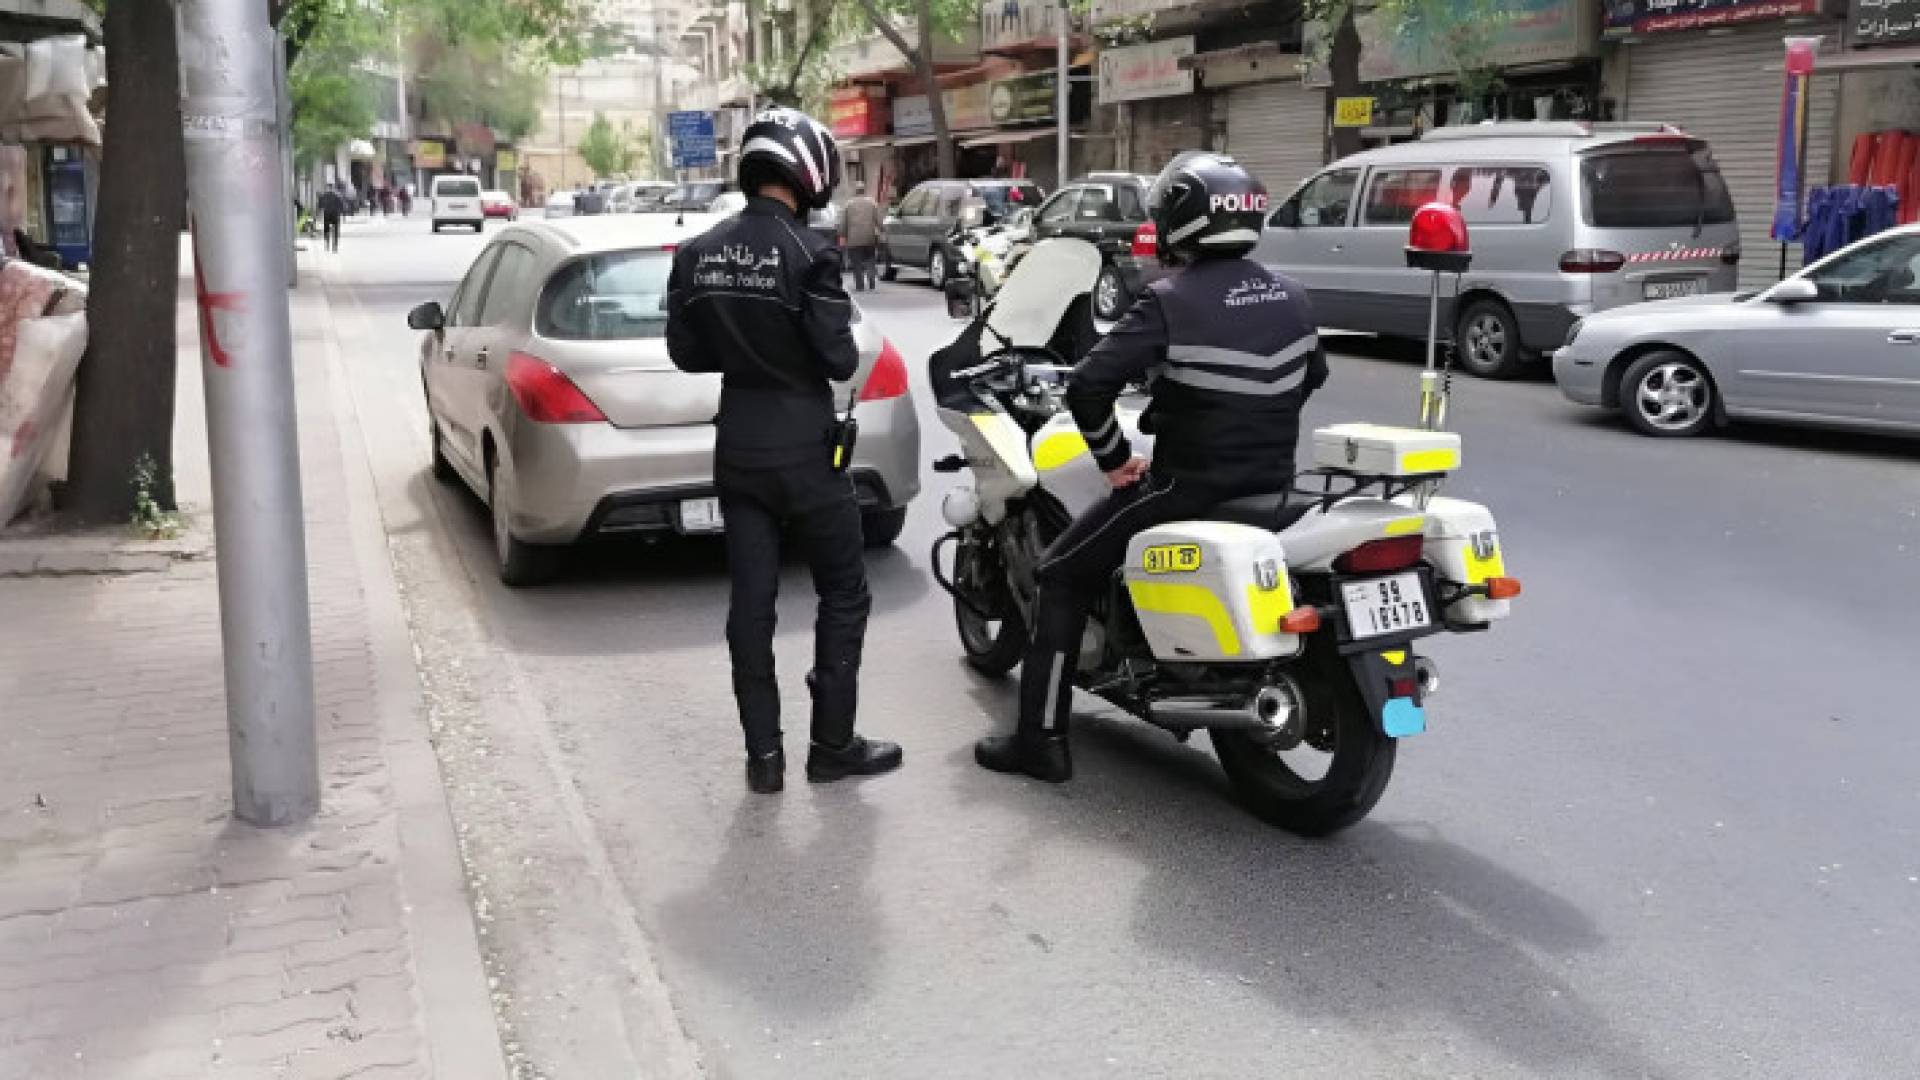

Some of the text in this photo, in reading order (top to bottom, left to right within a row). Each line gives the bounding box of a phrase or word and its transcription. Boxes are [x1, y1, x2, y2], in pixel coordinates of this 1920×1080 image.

[696, 243, 780, 271] شرطة السير
[736, 272, 776, 289] Police
[1147, 550, 1173, 569] 911
[1379, 579, 1402, 606] 99
